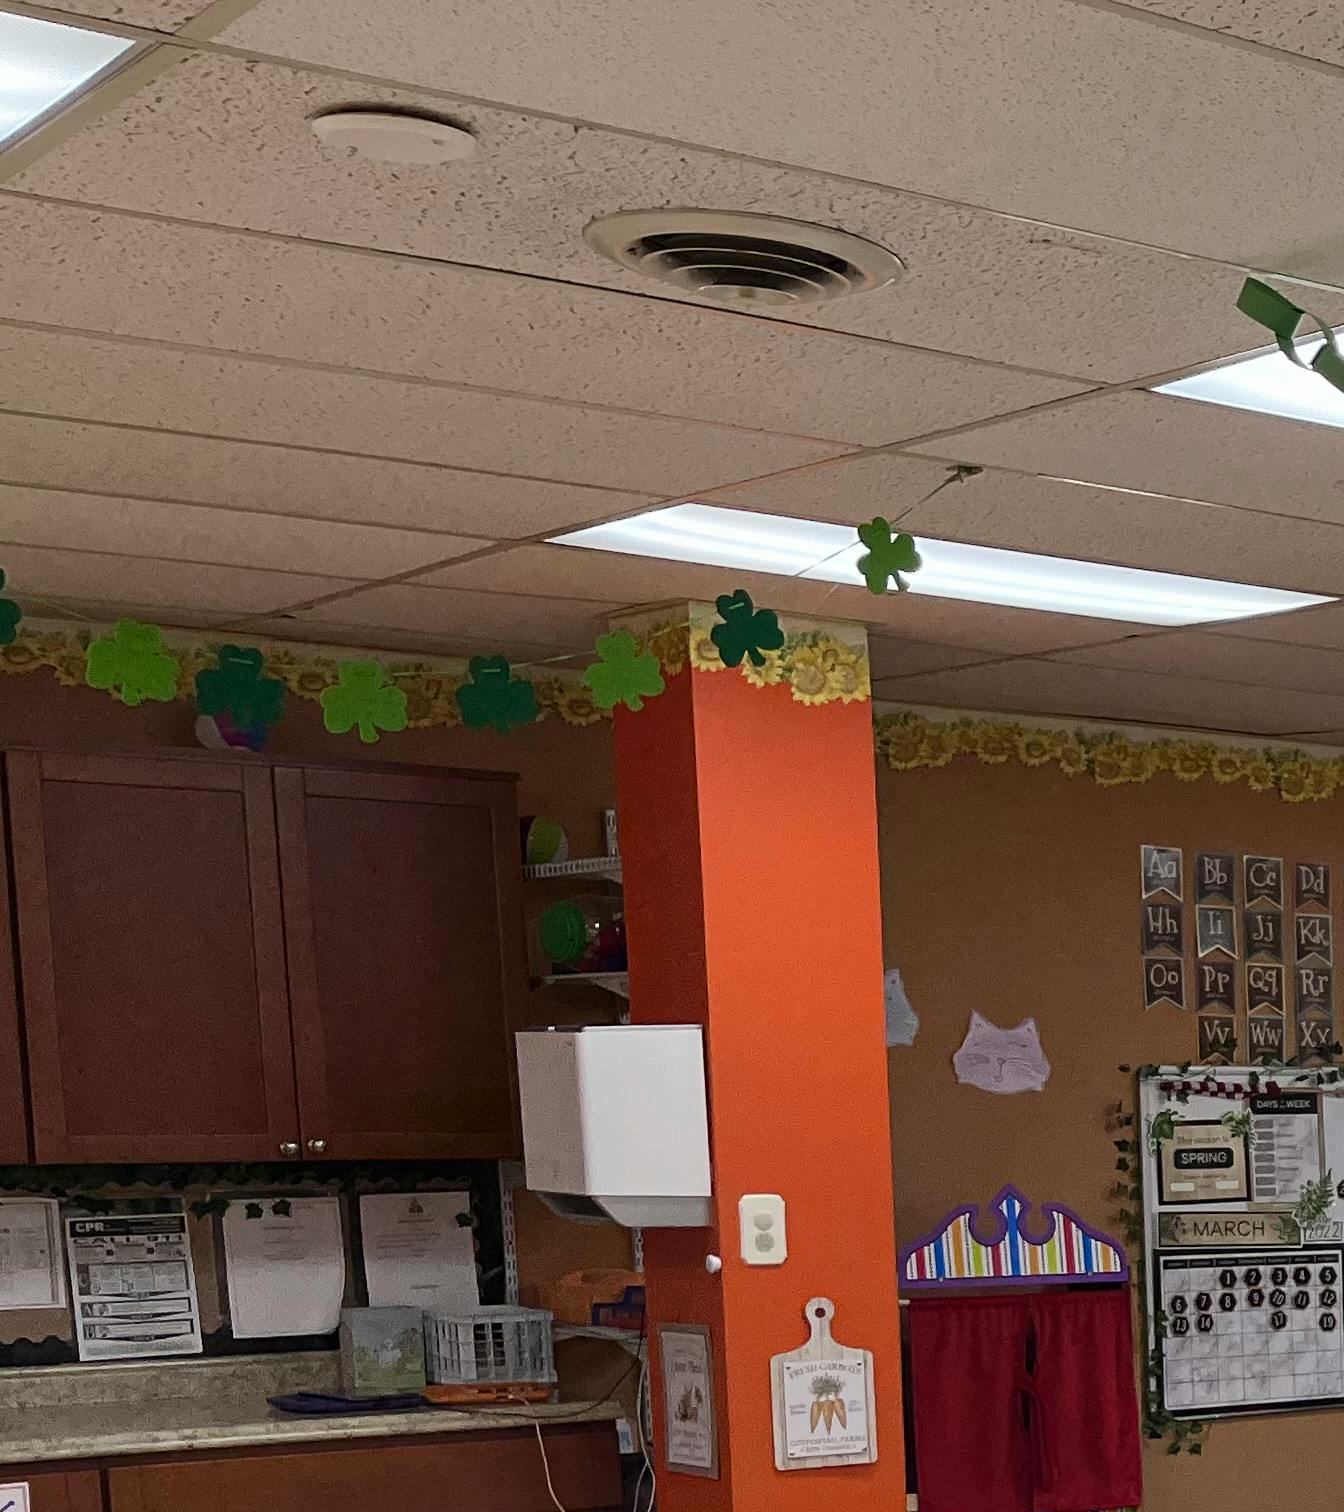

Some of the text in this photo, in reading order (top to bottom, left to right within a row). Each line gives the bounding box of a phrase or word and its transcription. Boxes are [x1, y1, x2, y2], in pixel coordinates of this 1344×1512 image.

[1148, 851, 1177, 879] Aa
[1204, 857, 1228, 885] Bb
[1251, 863, 1277, 887] Cc
[1299, 866, 1325, 894] Dd
[1148, 907, 1179, 934] Hh
[1208, 911, 1223, 935] Ii
[1253, 915, 1274, 942] Jj
[1299, 919, 1330, 946] Kk
[1150, 964, 1179, 987] Oo
[1203, 966, 1230, 993] Pp
[1250, 967, 1279, 996] Qq
[1300, 969, 1329, 997] Rr
[1204, 1020, 1231, 1044] Vv
[1250, 1021, 1282, 1047] Ww
[1301, 1021, 1330, 1048] Xx
[1256, 1100, 1279, 1109] DAYS
[1286, 1100, 1311, 1109] WEEK
[1180, 1151, 1228, 1165] SPRING
[75, 1222, 104, 1233] CPR
[1193, 1220, 1265, 1237] MARCH
[1307, 1223, 1340, 1239] 2022
[1249, 1271, 1257, 1283] 2
[1277, 1270, 1283, 1282] 3
[1299, 1270, 1305, 1281] 4
[1325, 1269, 1332, 1282] 5
[1175, 1291, 1335, 1312] 6 7 8 9 10 11 12
[1175, 1313, 1333, 1332] 13 14 17 19
